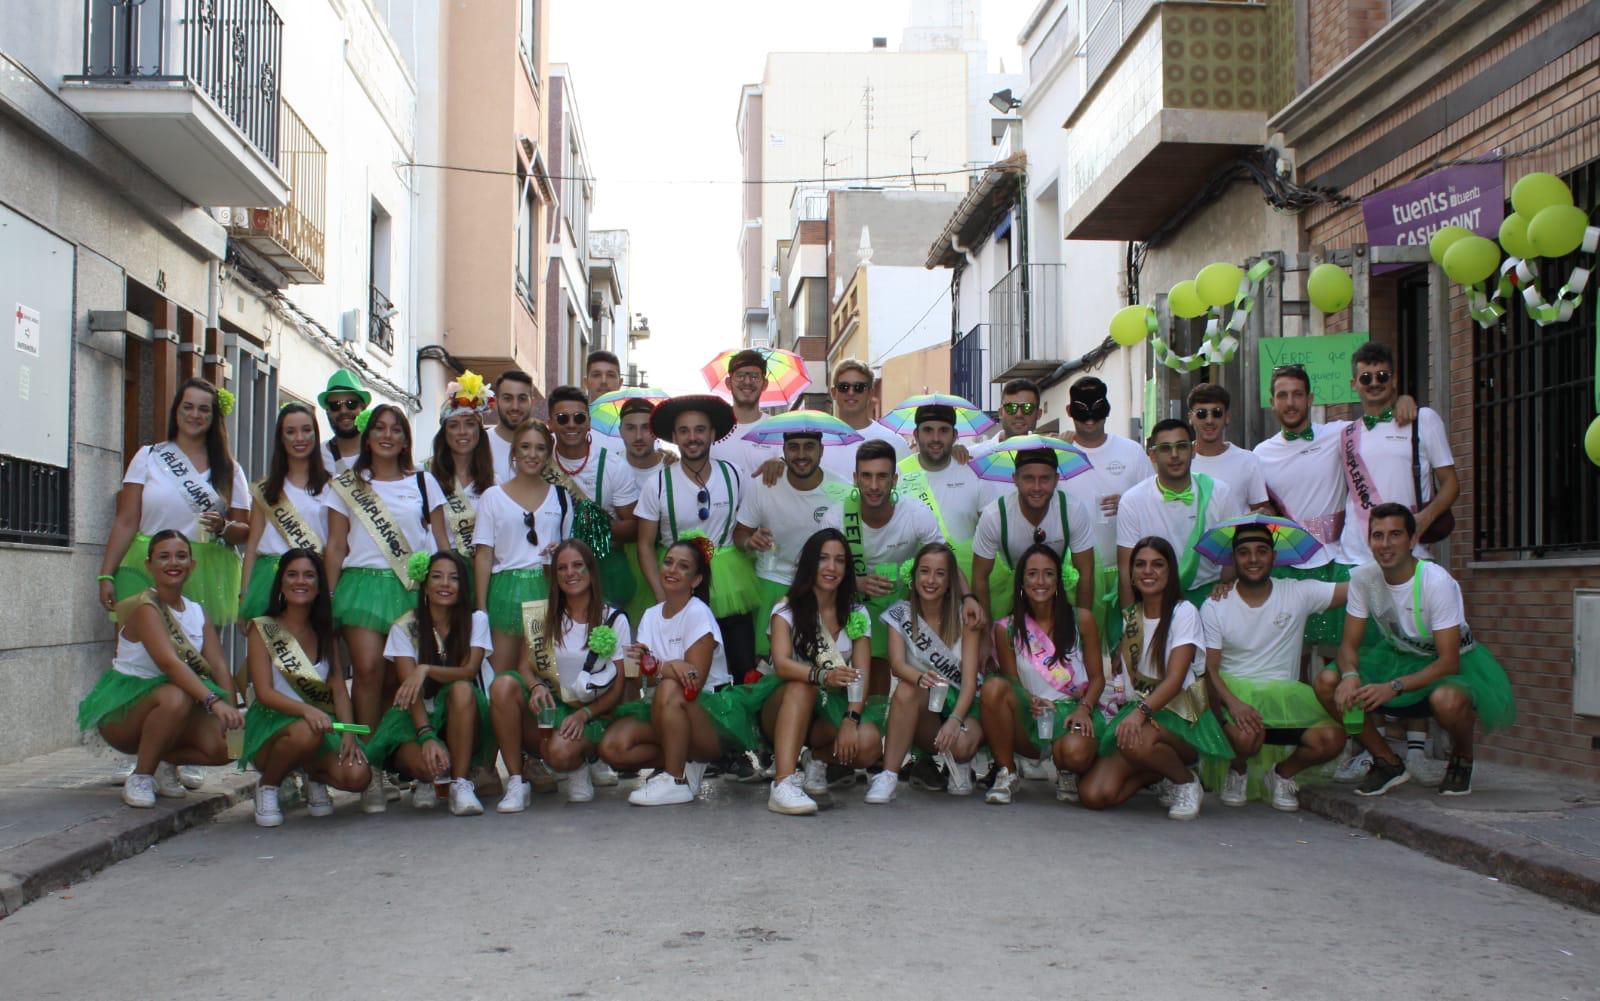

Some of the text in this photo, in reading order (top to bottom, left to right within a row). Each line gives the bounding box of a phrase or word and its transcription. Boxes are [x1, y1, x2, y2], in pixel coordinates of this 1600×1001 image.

[1392, 190, 1448, 225] tuents
[1327, 350, 1346, 366] que
[160, 450, 189, 478] FELIZ
[272, 639, 303, 672] FELIZ
[929, 652, 961, 683] CUMP
